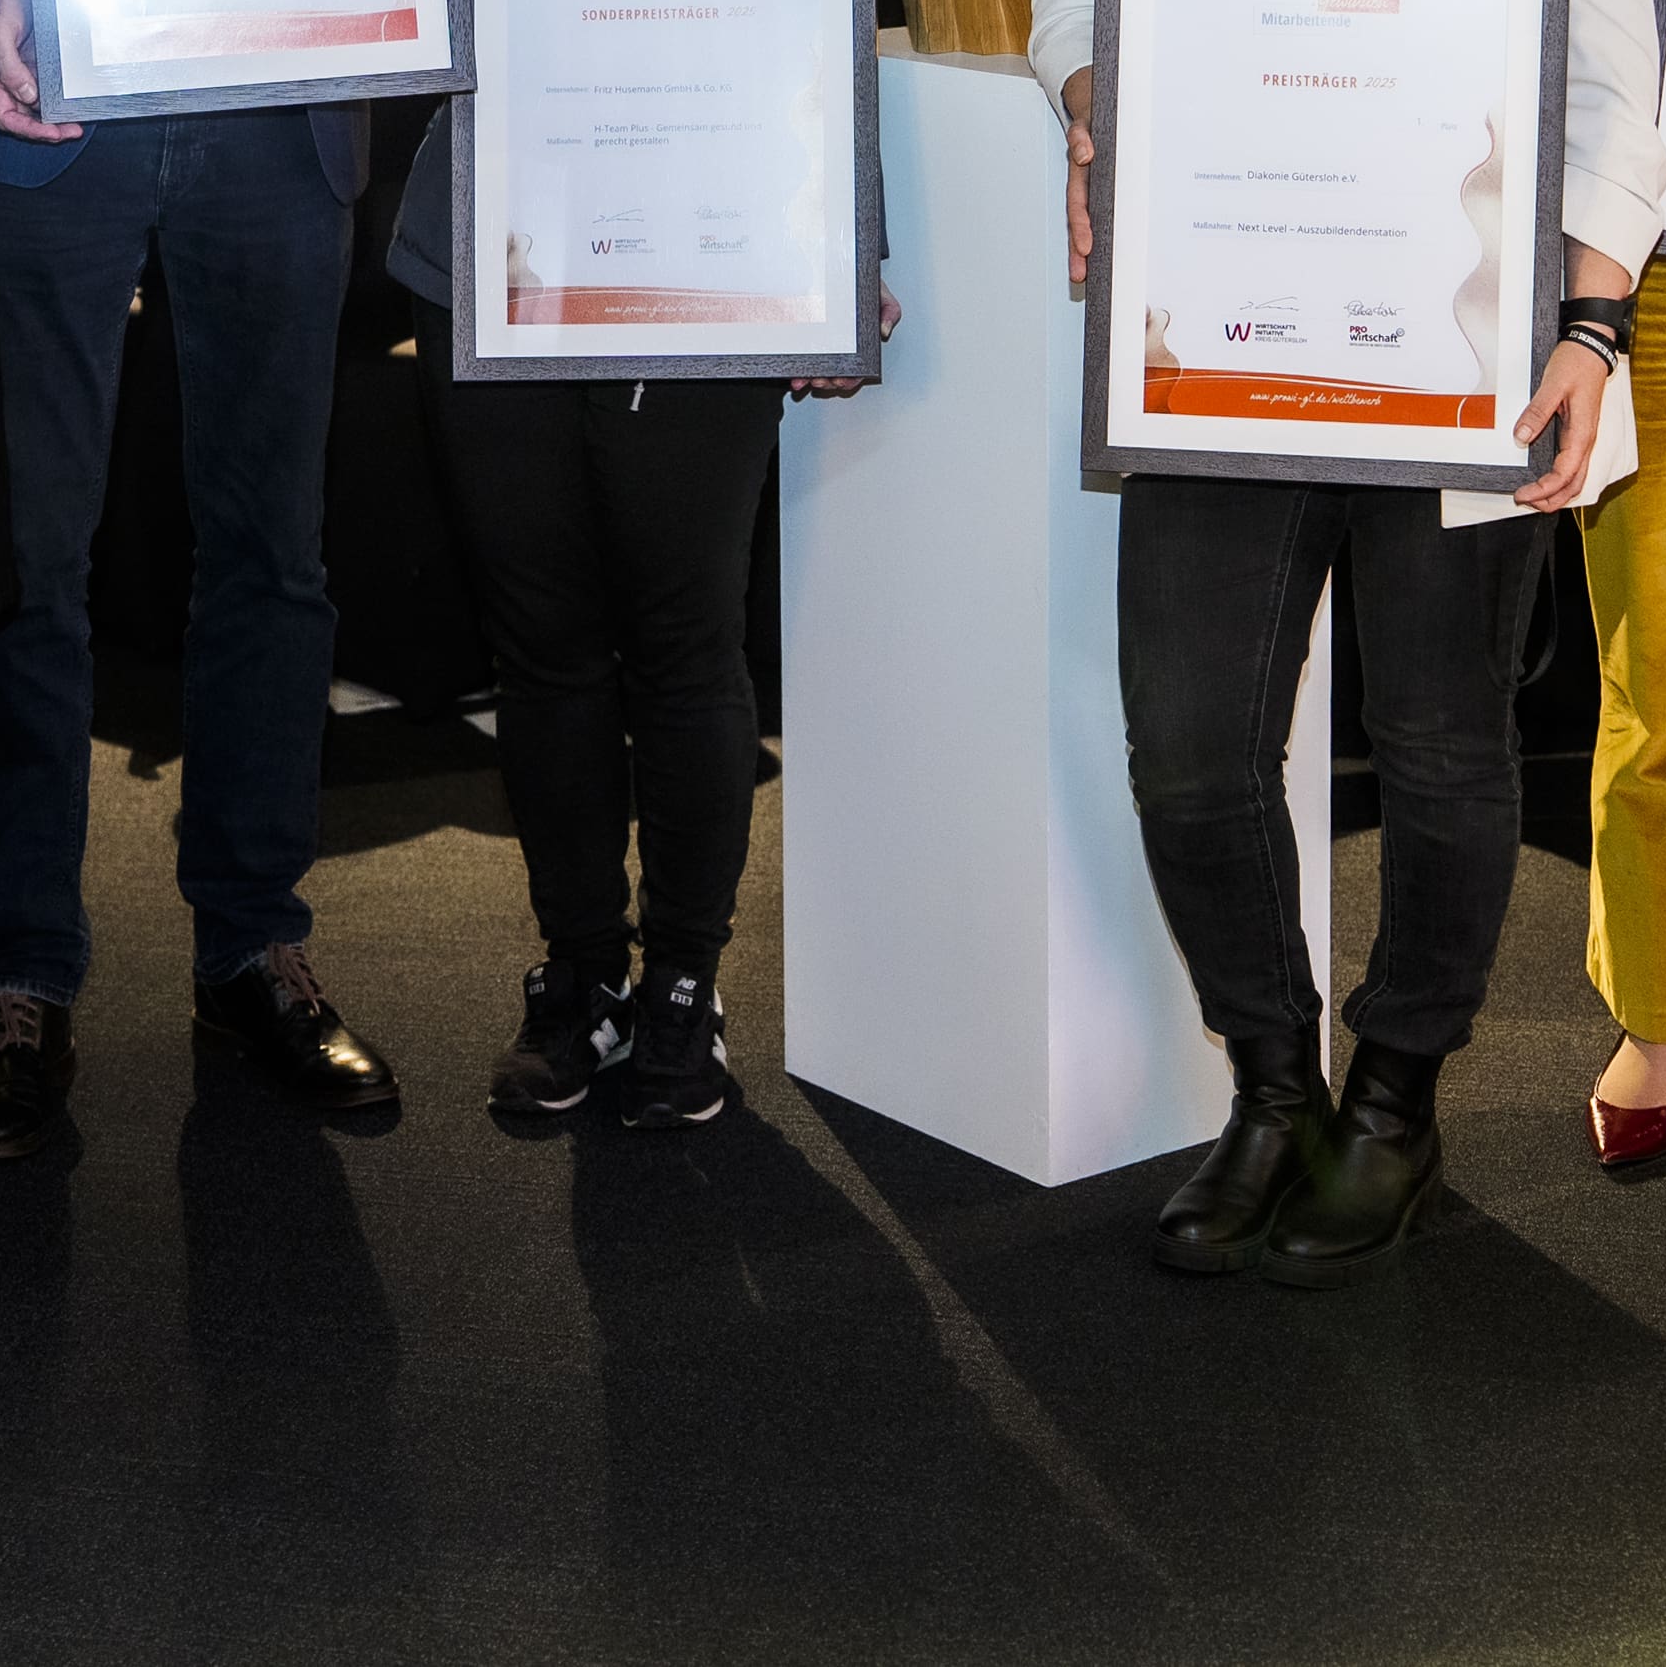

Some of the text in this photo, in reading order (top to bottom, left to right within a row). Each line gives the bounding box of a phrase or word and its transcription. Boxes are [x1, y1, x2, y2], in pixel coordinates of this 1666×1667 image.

[580, 5, 720, 21] SONDERPREISTRÄGER
[1261, 11, 1352, 28] Mitarbeitende
[1262, 71, 1398, 89] PREISTRÄGER 2025
[594, 84, 613, 94] Fritz
[614, 84, 662, 94] Husemann
[664, 84, 693, 94] GmbH
[694, 84, 702, 93] &
[703, 84, 716, 94] Co.
[594, 123, 629, 133] H-Team
[630, 123, 650, 133] Plus
[655, 122, 708, 132] Gemeinsam
[710, 121, 742, 134] gesund
[593, 135, 670, 147] gerecht gestalten
[1247, 170, 1290, 181] Diakonie
[1291, 171, 1339, 183] Gütersloh
[1341, 173, 1360, 183] e.V.
[1237, 222, 1260, 233] Next
[1262, 223, 1287, 234] Level
[1296, 224, 1408, 238] Auszubildendenstation
[591, 238, 612, 254] W
[1225, 322, 1297, 342] W WIRTSCHAFTS
[1349, 325, 1368, 334] PRO
[1249, 391, 1382, 409] www.prowi-gt.de/wettbewerb
